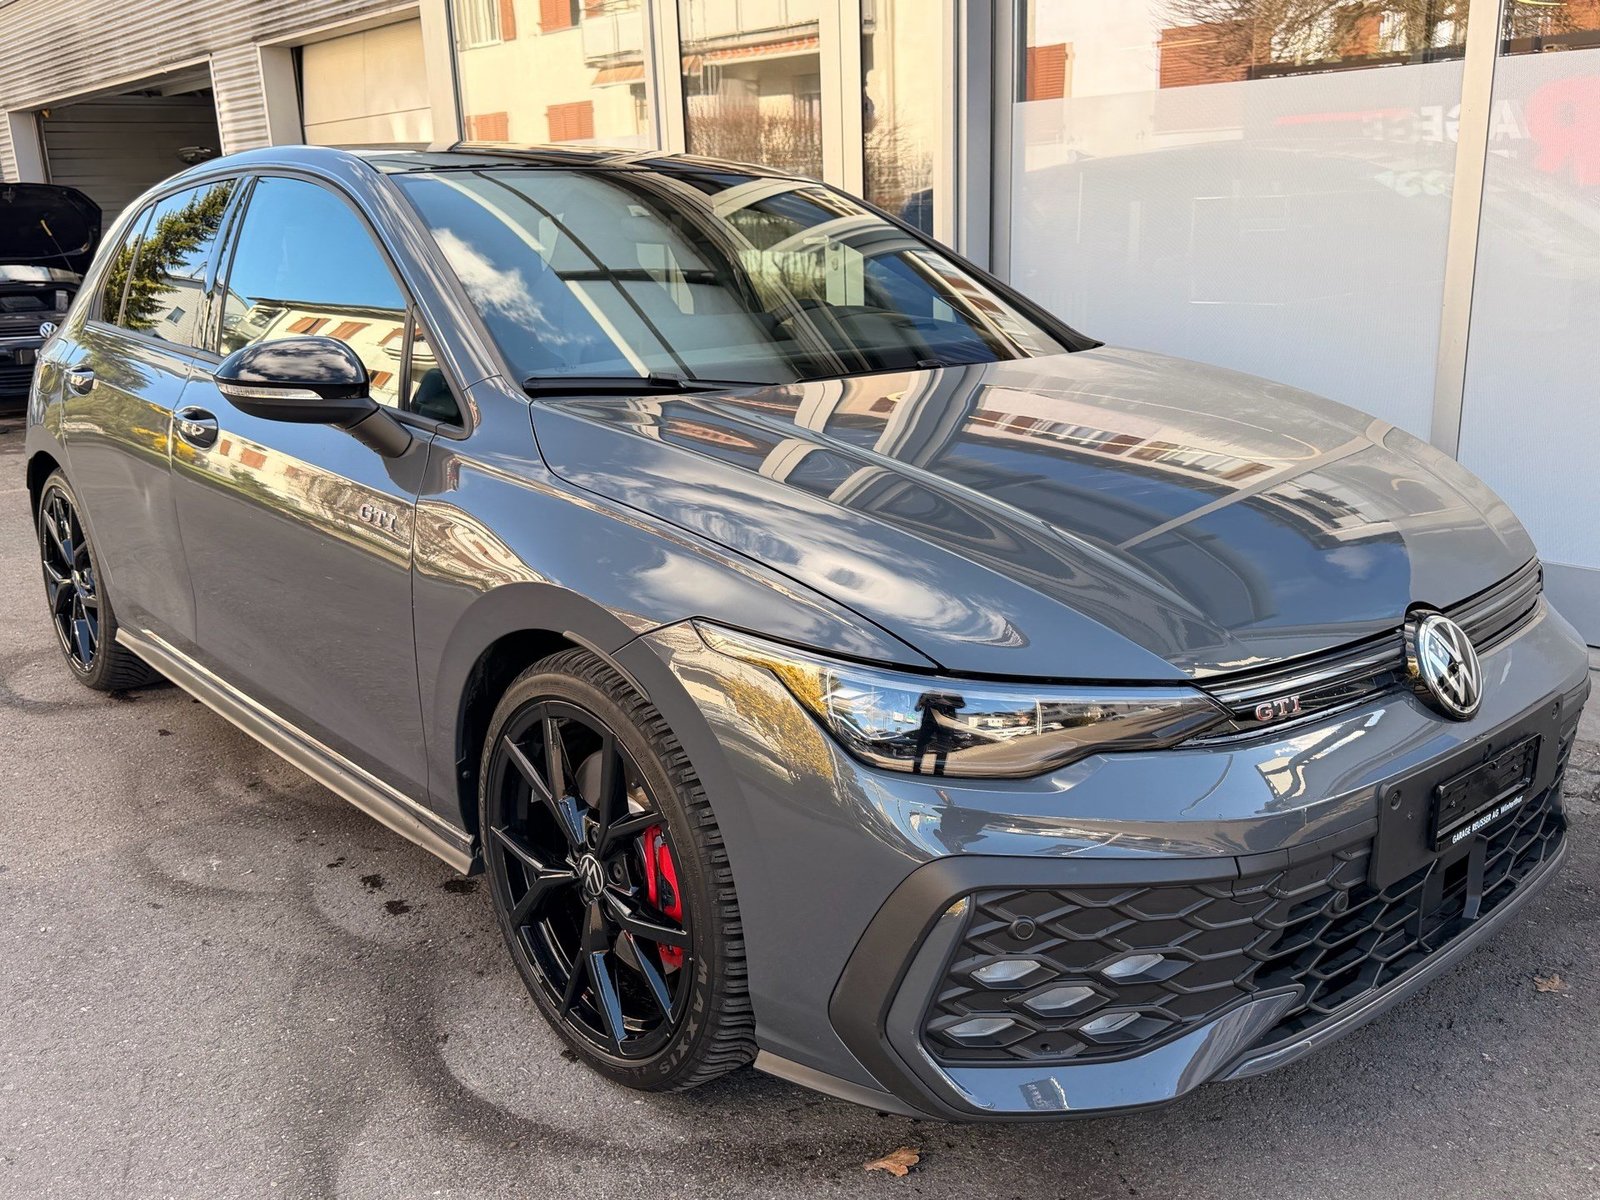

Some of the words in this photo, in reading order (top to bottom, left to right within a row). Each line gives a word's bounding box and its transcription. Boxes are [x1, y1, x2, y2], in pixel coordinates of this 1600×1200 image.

[360, 503, 397, 531] GTI
[1256, 695, 1302, 721] GTI
[1452, 825, 1471, 844] GARAGE
[1492, 808, 1500, 819] AG
[659, 954, 708, 1075] MAXXIS
